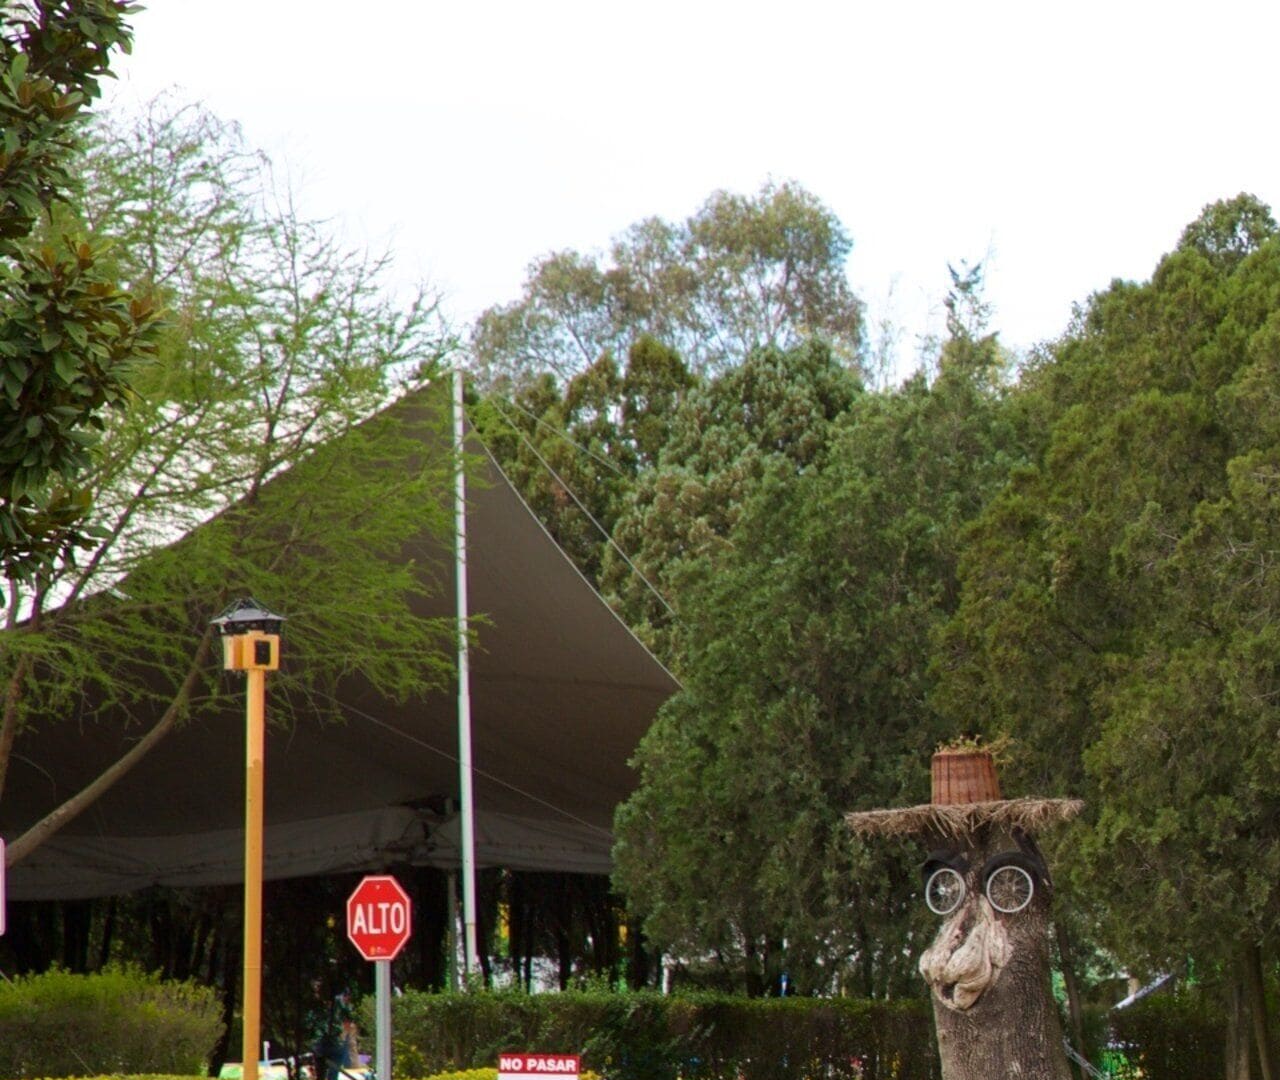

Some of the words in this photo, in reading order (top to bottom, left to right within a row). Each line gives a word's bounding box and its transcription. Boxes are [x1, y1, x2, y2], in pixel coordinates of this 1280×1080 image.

[352, 902, 405, 935] ALTO
[500, 1058, 523, 1071] NO
[527, 1059, 577, 1072] PASAR
